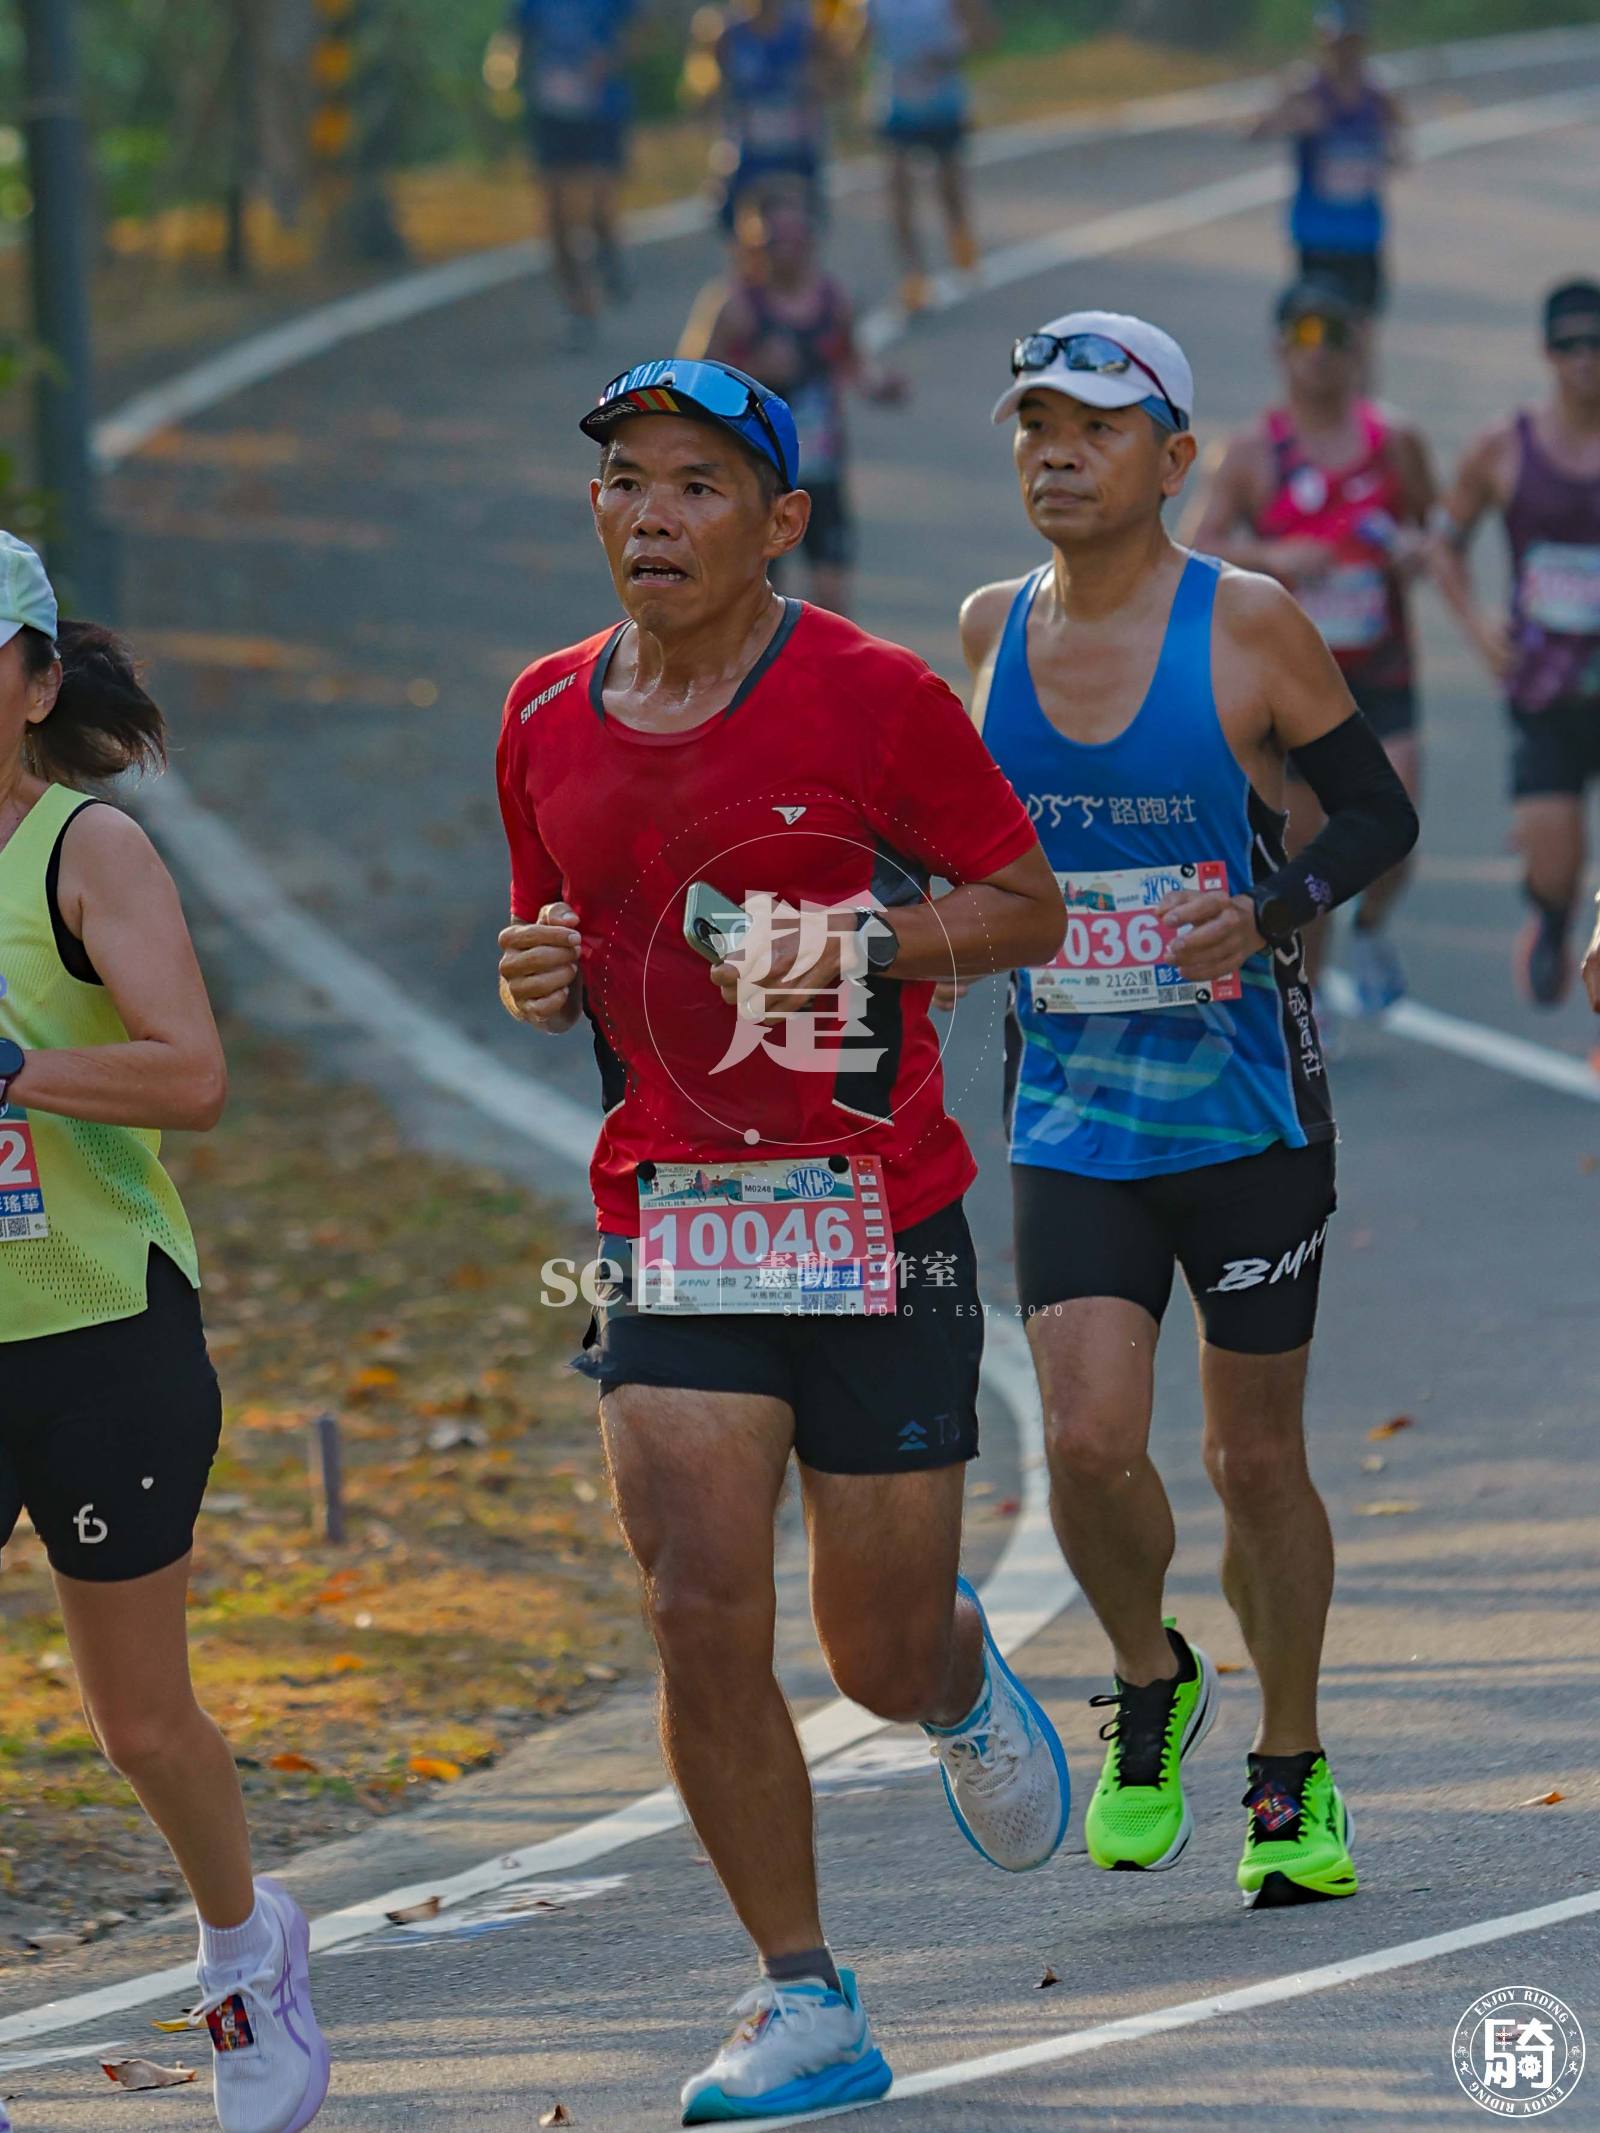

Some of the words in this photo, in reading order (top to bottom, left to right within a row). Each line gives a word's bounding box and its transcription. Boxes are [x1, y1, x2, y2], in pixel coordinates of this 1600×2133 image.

[1108, 794, 1197, 825] 路跑社
[744, 1184, 772, 1194] M0248
[649, 1207, 855, 1267] 10046
